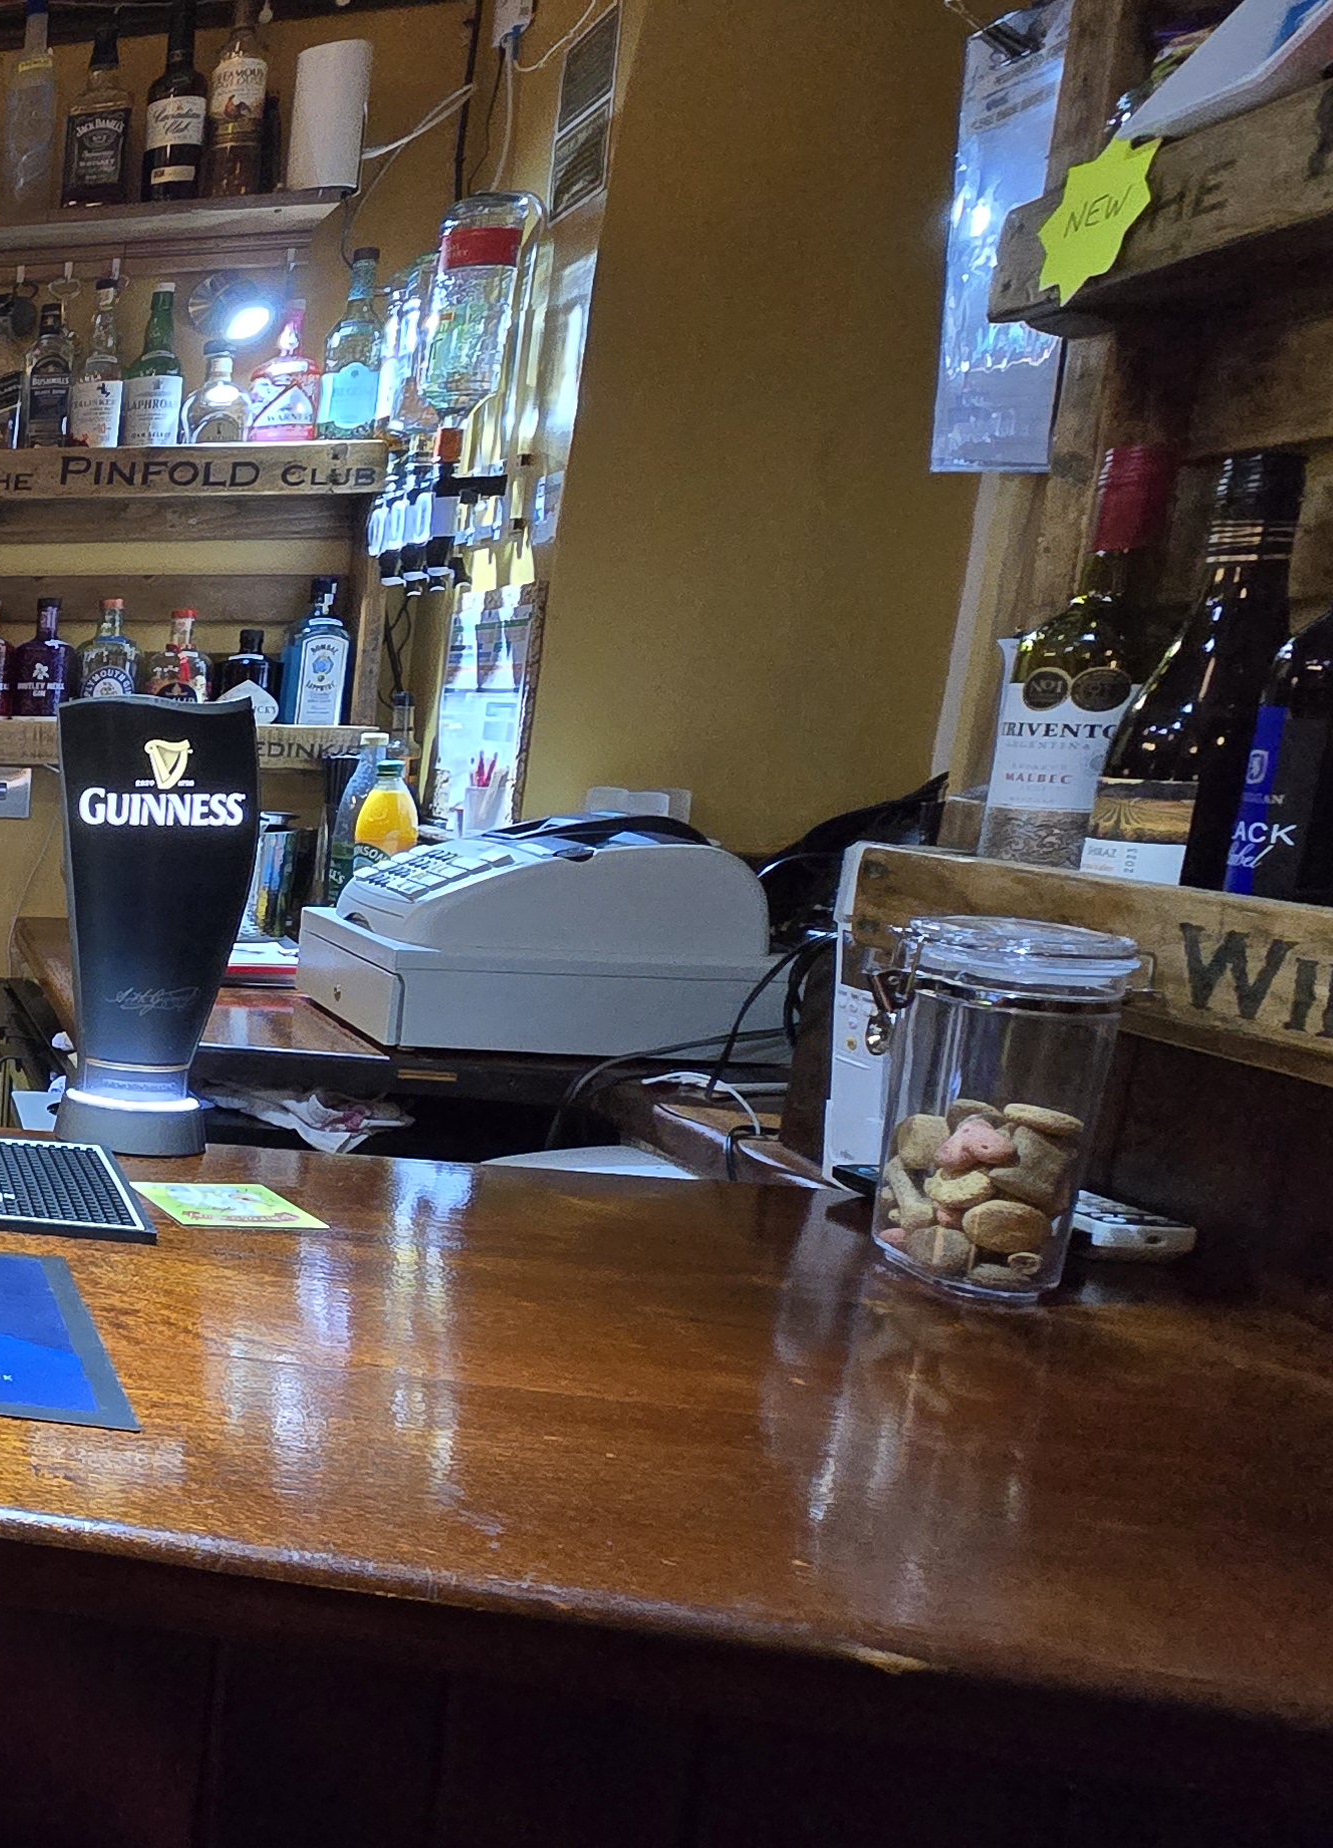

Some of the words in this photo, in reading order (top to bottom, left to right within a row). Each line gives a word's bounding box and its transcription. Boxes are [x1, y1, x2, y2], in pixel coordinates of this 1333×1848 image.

[76, 121, 95, 137] JACK
[96, 119, 125, 134] DANIEL'S
[1063, 185, 1133, 238] NEW
[59, 456, 261, 488] PINFOLD
[282, 464, 376, 487] CLUB
[311, 644, 339, 655] BOMBAY
[84, 670, 126, 698] PLYMOUTH
[1004, 773, 1073, 785] MALBEC
[79, 787, 247, 826] GUINNESS
[1231, 821, 1297, 846] ACK
